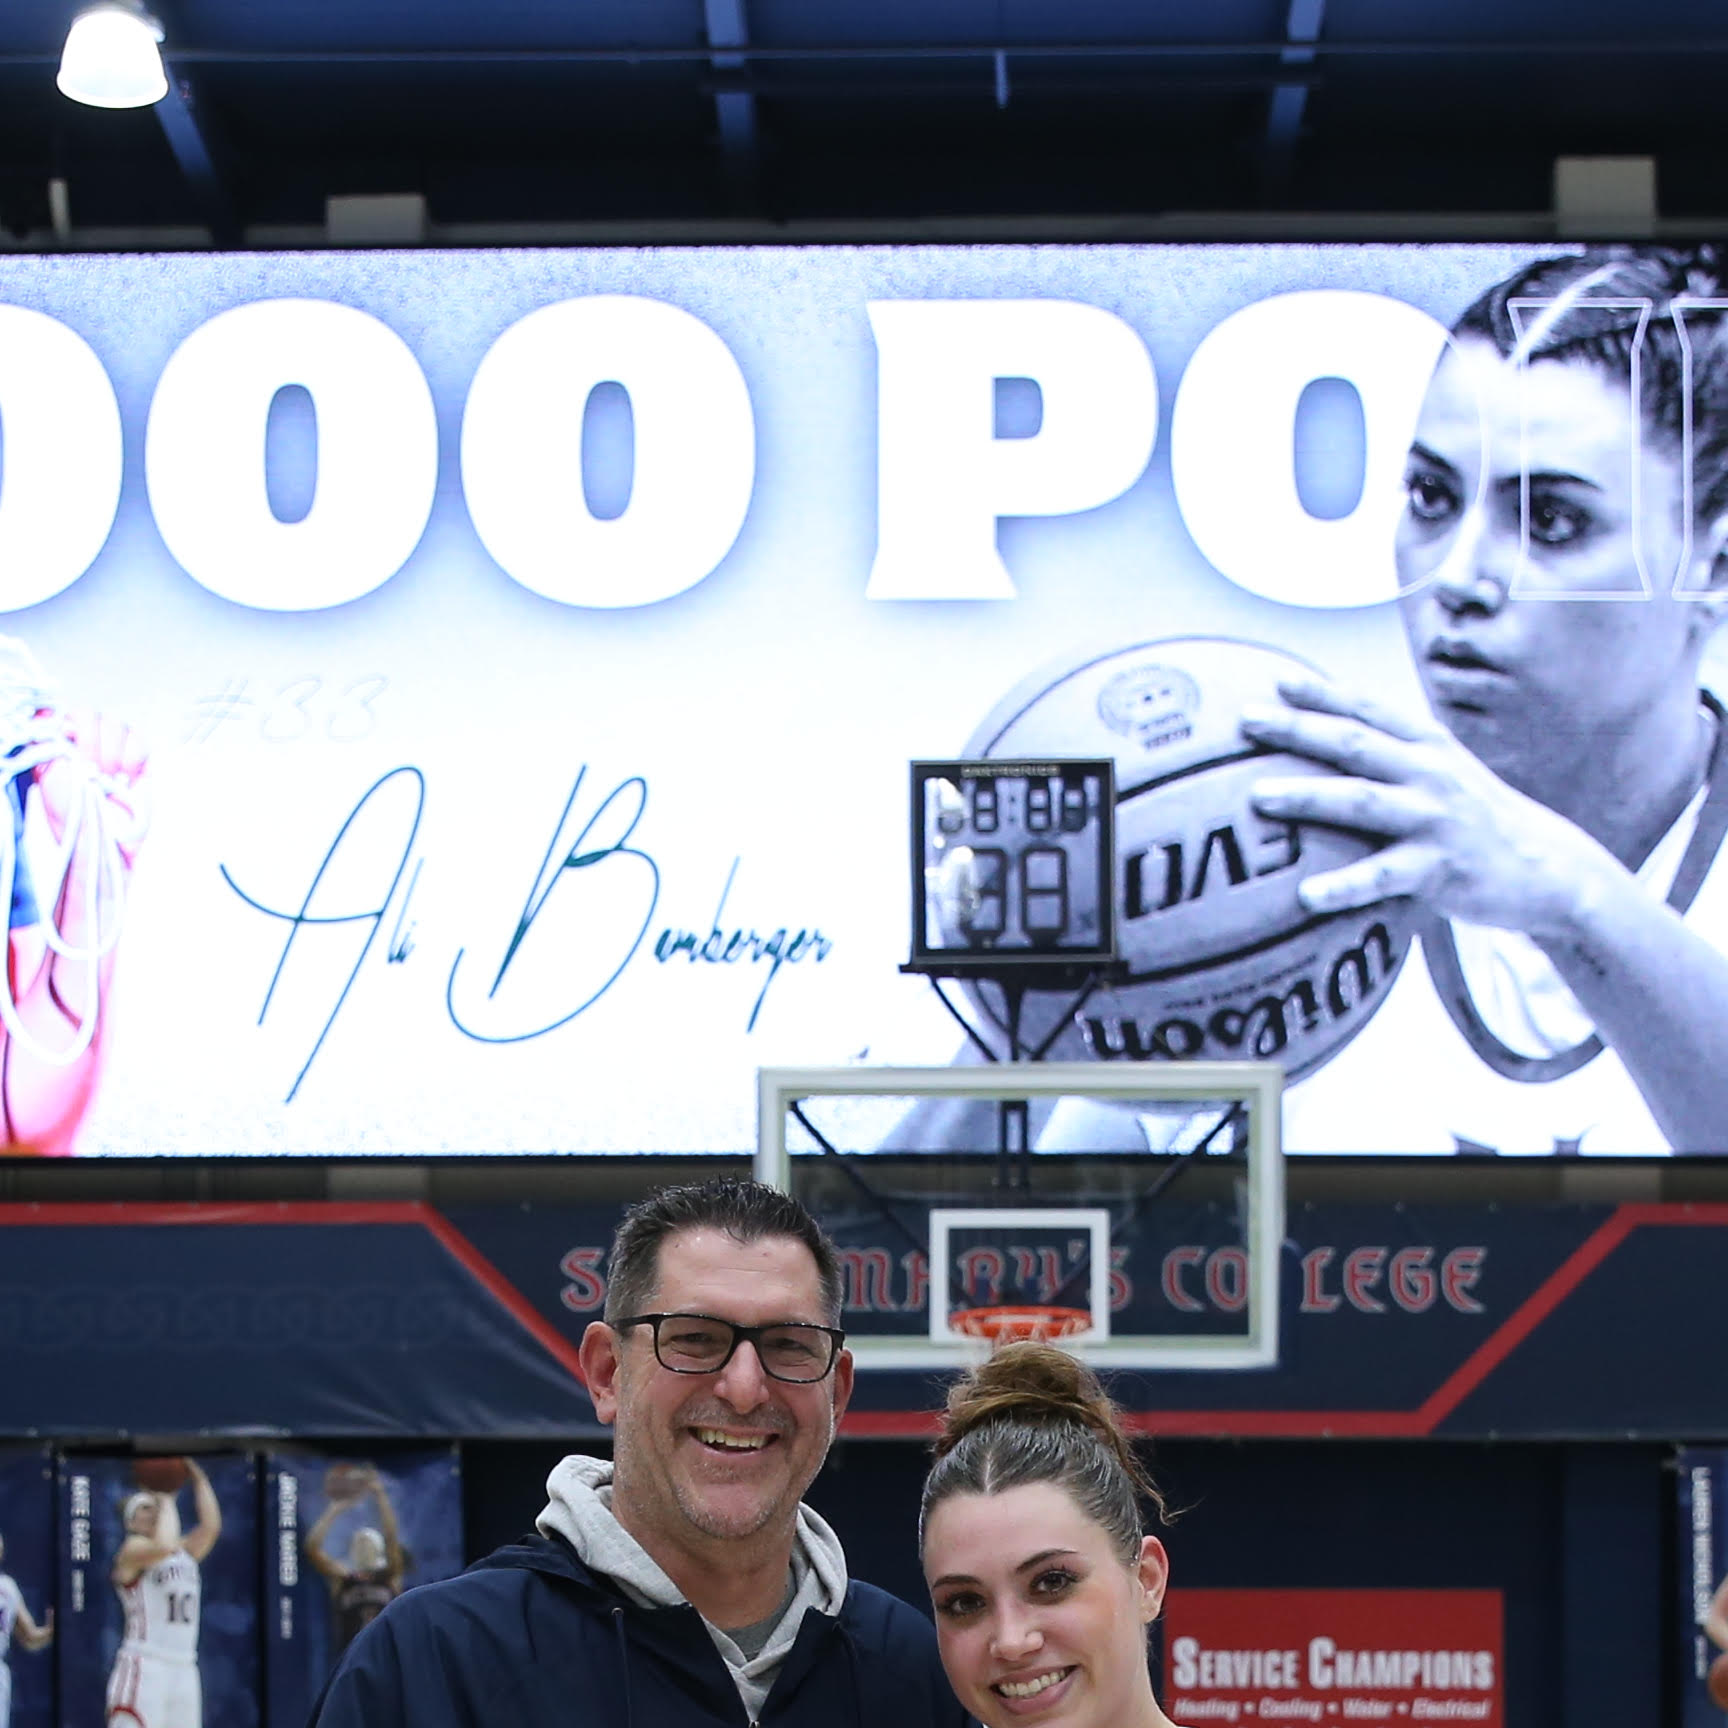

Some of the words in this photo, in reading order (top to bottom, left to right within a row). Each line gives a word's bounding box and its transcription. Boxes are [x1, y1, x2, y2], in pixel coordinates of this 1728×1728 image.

[1162, 1244, 1487, 1314] COLEGE
[1172, 1636, 1300, 1690] SERVICE
[1308, 1636, 1495, 1690] CHAMPIONS
[1173, 1697, 1240, 1722] Heating
[1258, 1697, 1323, 1722] Cooling
[1342, 1698, 1393, 1718] Water
[1410, 1697, 1491, 1719] Electrical
